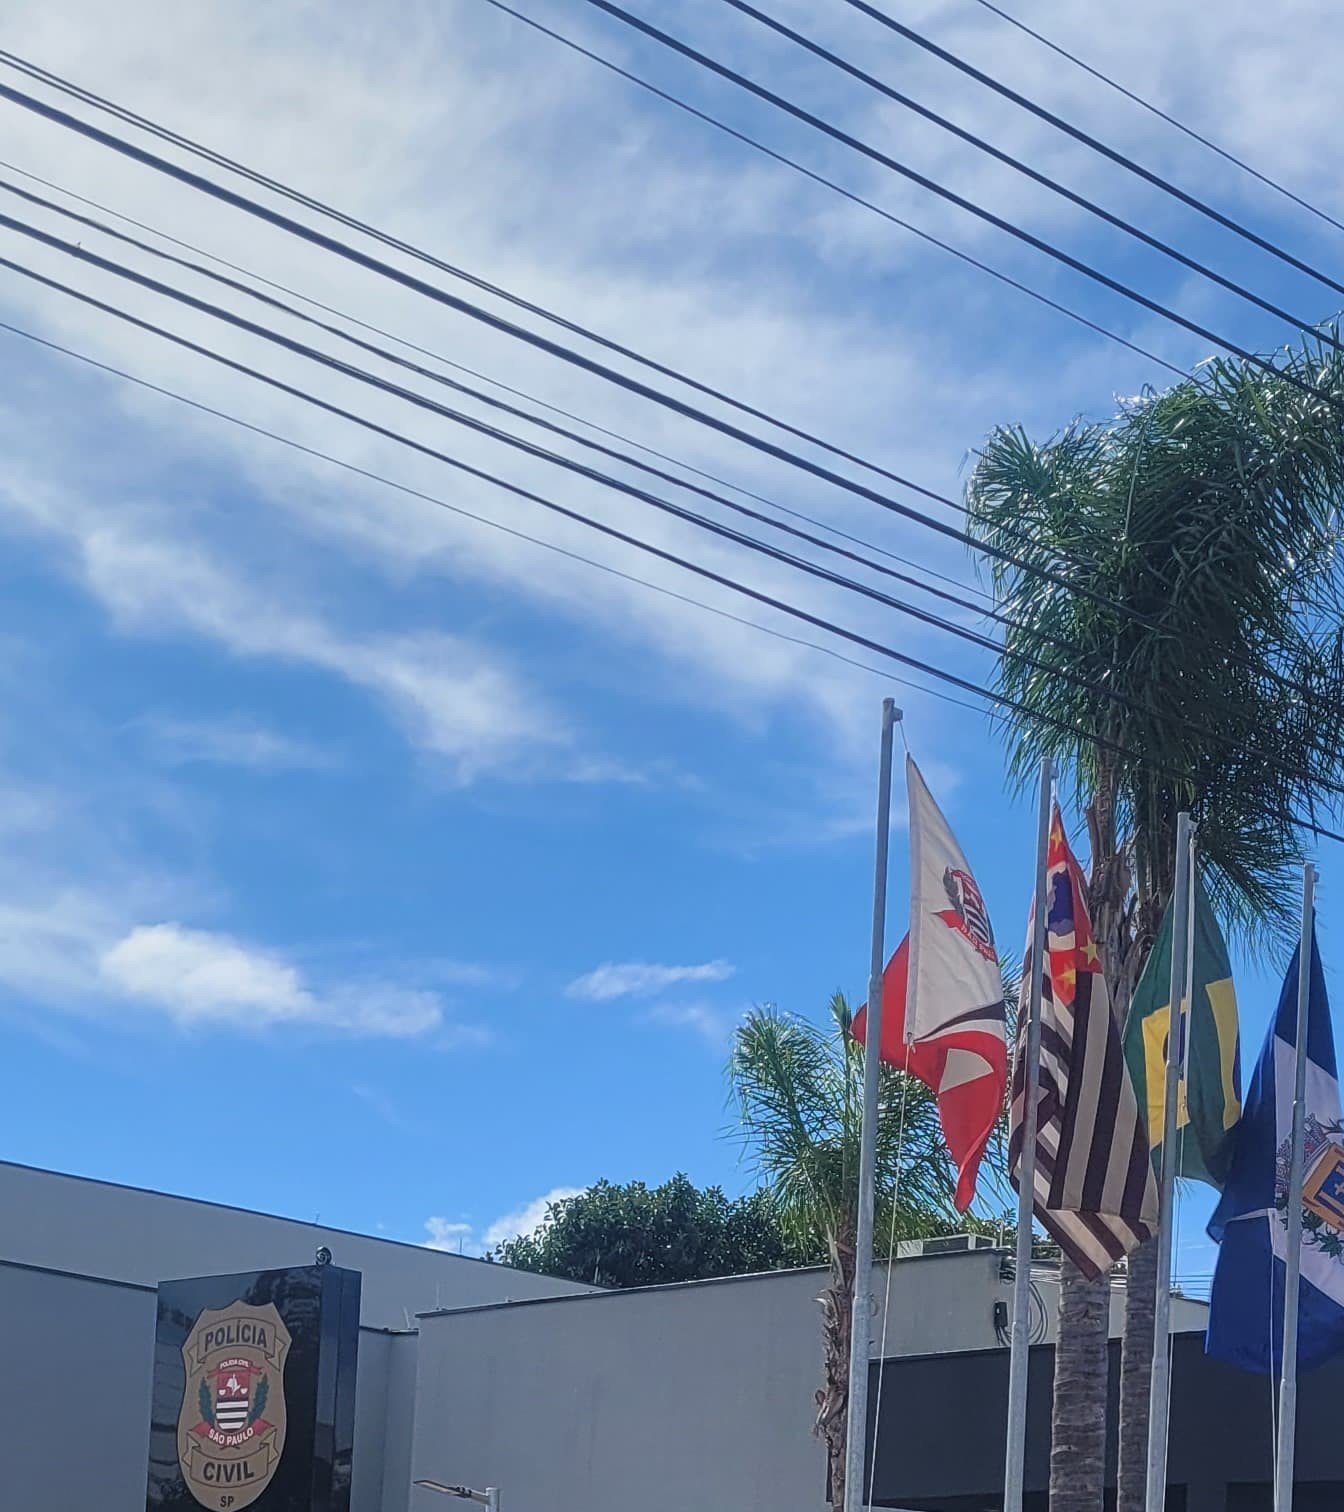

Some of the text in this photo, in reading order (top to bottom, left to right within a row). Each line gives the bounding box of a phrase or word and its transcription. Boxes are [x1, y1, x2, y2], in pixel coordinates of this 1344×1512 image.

[205, 1320, 267, 1348] POLÍCIA
[227, 1427, 254, 1446] PAULO
[202, 1460, 254, 1483] CIVIL
[219, 1495, 235, 1508] SP
